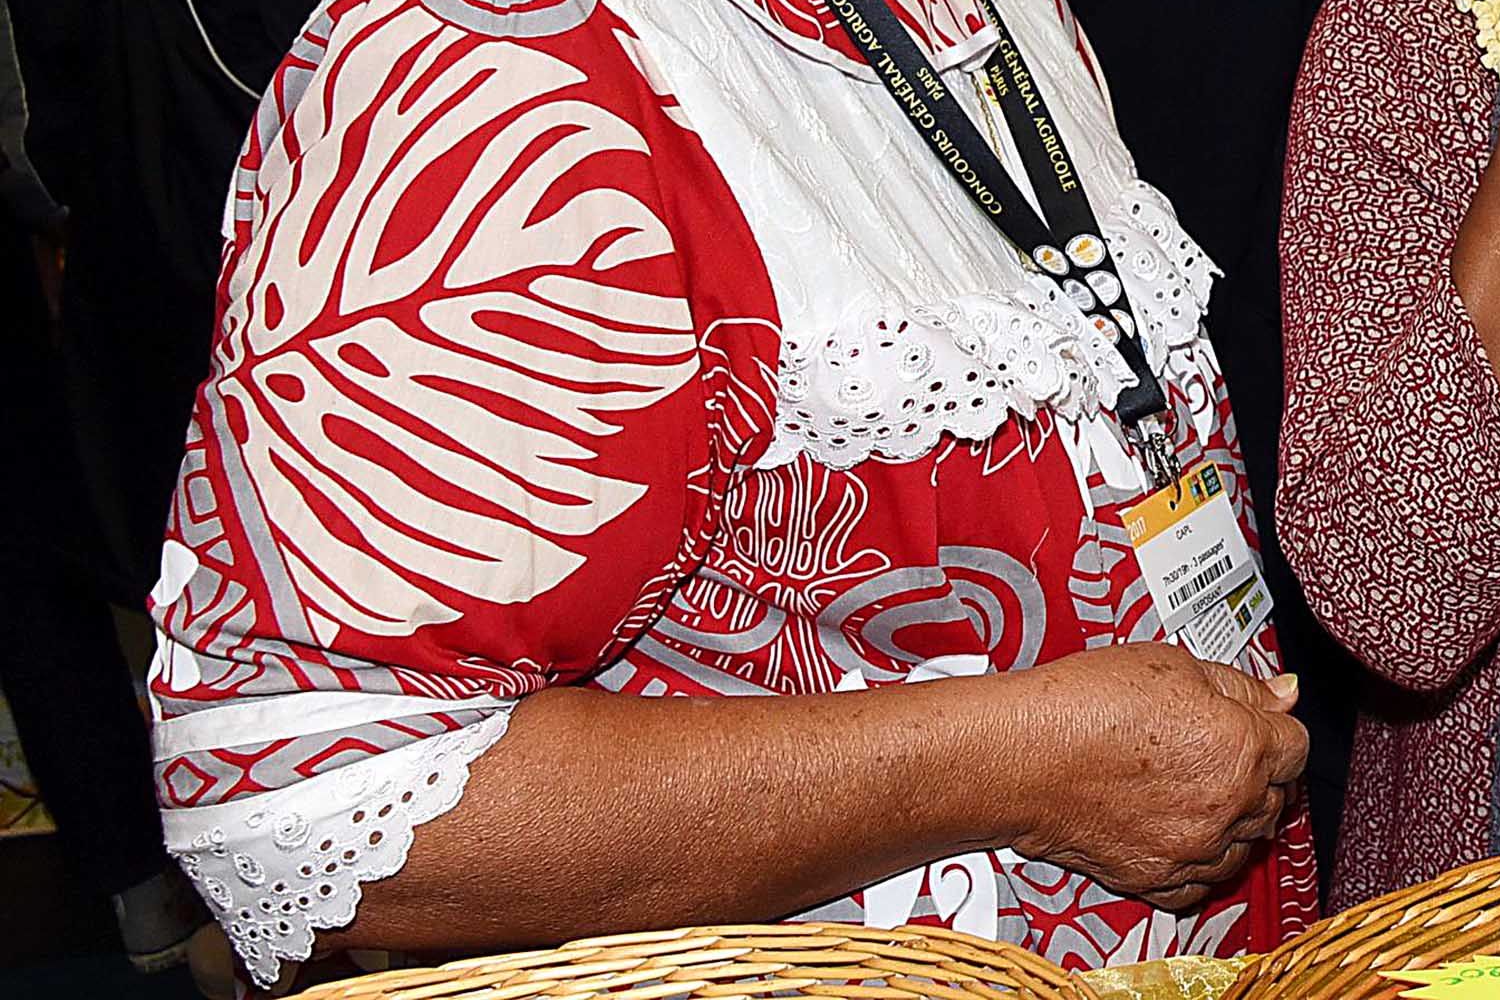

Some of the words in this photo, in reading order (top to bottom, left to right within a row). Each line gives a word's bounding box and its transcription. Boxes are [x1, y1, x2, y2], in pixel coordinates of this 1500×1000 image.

[877, 51, 937, 130] GÉNÉRAL
[916, 66, 946, 102] PARIS
[990, 64, 1009, 98] PARIS
[999, 39, 1040, 115] GÉNÉRAL
[1033, 116, 1078, 193] AGRICOLE
[931, 128, 1003, 216] CONCOURS
[1127, 516, 1147, 541] 2017
